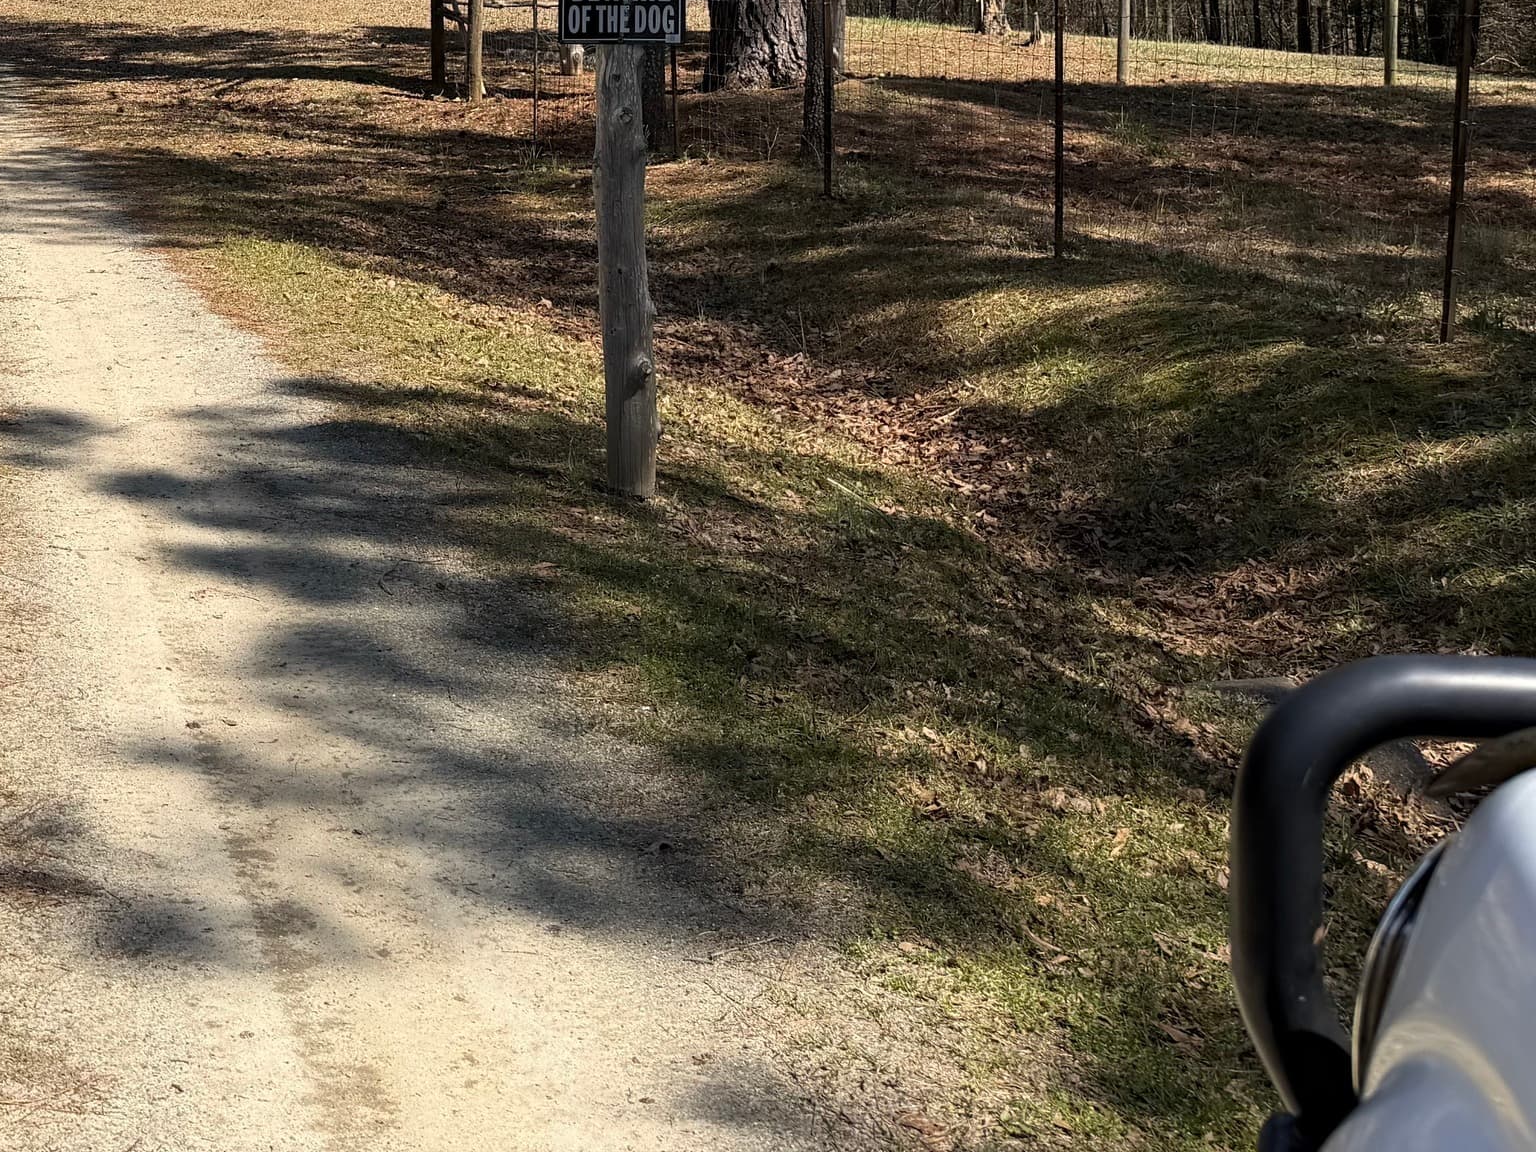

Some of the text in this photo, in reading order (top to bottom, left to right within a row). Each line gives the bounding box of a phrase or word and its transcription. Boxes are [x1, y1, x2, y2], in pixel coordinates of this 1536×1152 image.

[567, 4, 676, 34] OF THE DOG
